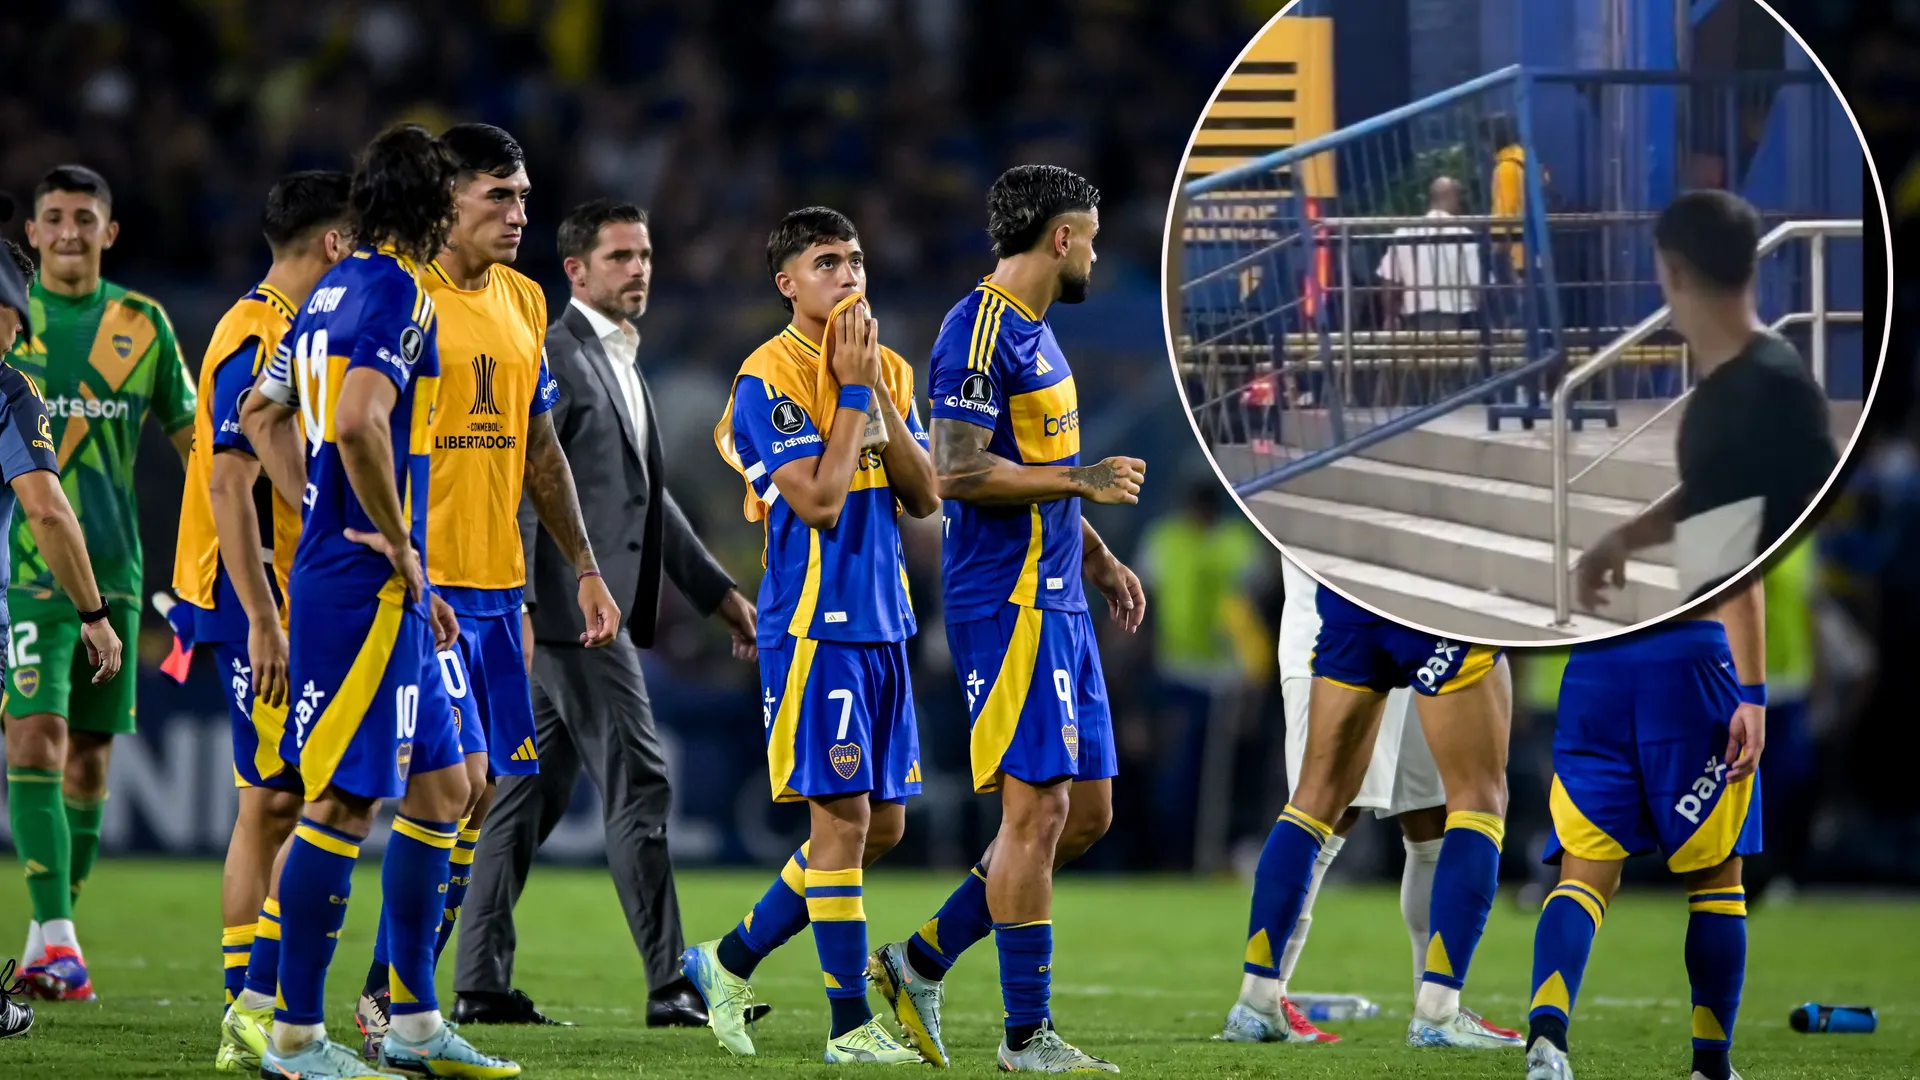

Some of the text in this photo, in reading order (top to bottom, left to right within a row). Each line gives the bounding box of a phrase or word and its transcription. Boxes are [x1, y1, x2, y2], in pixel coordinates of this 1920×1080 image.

[47, 395, 129, 421] etsson
[470, 422, 500, 432] CONMEBOL
[784, 434, 823, 448] CETROGA
[8, 620, 41, 669] 12
[1416, 637, 1461, 692] pax
[436, 649, 467, 699] 0
[1053, 668, 1075, 720] 9
[396, 684, 419, 740] 10
[827, 688, 854, 741] 7
[833, 754, 858, 764] CABJ
[1674, 755, 1728, 825] pax
